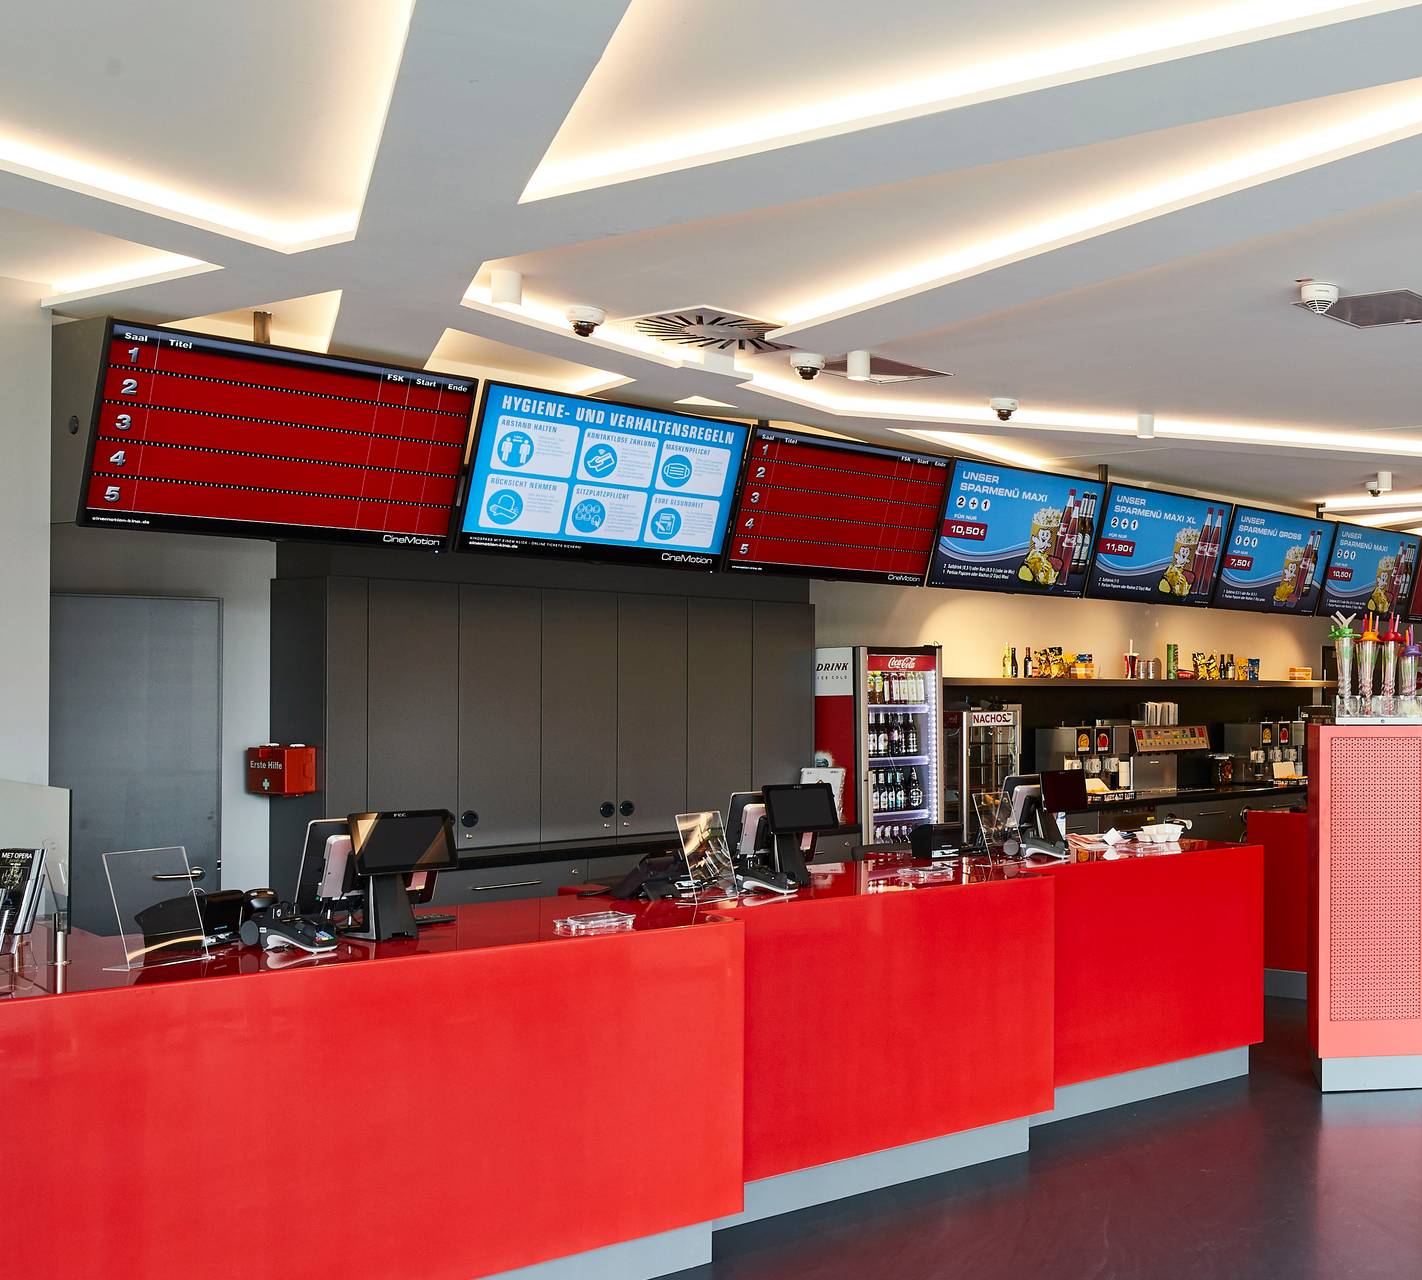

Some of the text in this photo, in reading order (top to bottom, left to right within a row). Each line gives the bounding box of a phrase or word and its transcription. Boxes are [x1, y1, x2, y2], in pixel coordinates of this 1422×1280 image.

[124, 331, 148, 343] Saal
[169, 338, 193, 350] Titel
[127, 347, 139, 363] 1
[387, 373, 404, 383] FSK
[416, 377, 437, 388] Start
[121, 378, 137, 395] 2
[447, 383, 468, 393] Ende
[115, 414, 131, 430] 3
[501, 419, 557, 433] ABSTAND HALTEN
[502, 395, 734, 445] HYGIENE- UND VERHALTENSREGELN
[586, 431, 656, 448] KONTAKTLOSE ZAHLUNG
[761, 433, 774, 441] Saal
[665, 443, 711, 456] MASKENPFLICHT
[762, 444, 769, 455] 1
[109, 450, 126, 466] 4
[756, 467, 766, 478] 2
[962, 471, 1000, 484] UNSER
[529, 482, 558, 492] NEHMEN
[959, 483, 1048, 503] SPARMENÜ MAXI
[104, 486, 120, 502] 5
[575, 488, 630, 500] SITZPLATZPFLICHT
[751, 492, 760, 503] 3
[1116, 494, 1147, 506] UNSER
[958, 497, 964, 507] 2
[1114, 505, 1197, 524] SPARMENÜ MAXI XL
[1240, 515, 1265, 526] UNSER
[745, 518, 754, 529] 4
[382, 534, 440, 547] CineMotion
[739, 543, 749, 555] 5
[661, 552, 713, 565] CineMotion
[816, 662, 848, 672] DRINK
[973, 713, 1007, 724] NACHOS
[250, 760, 283, 770] Erste Hilfe
